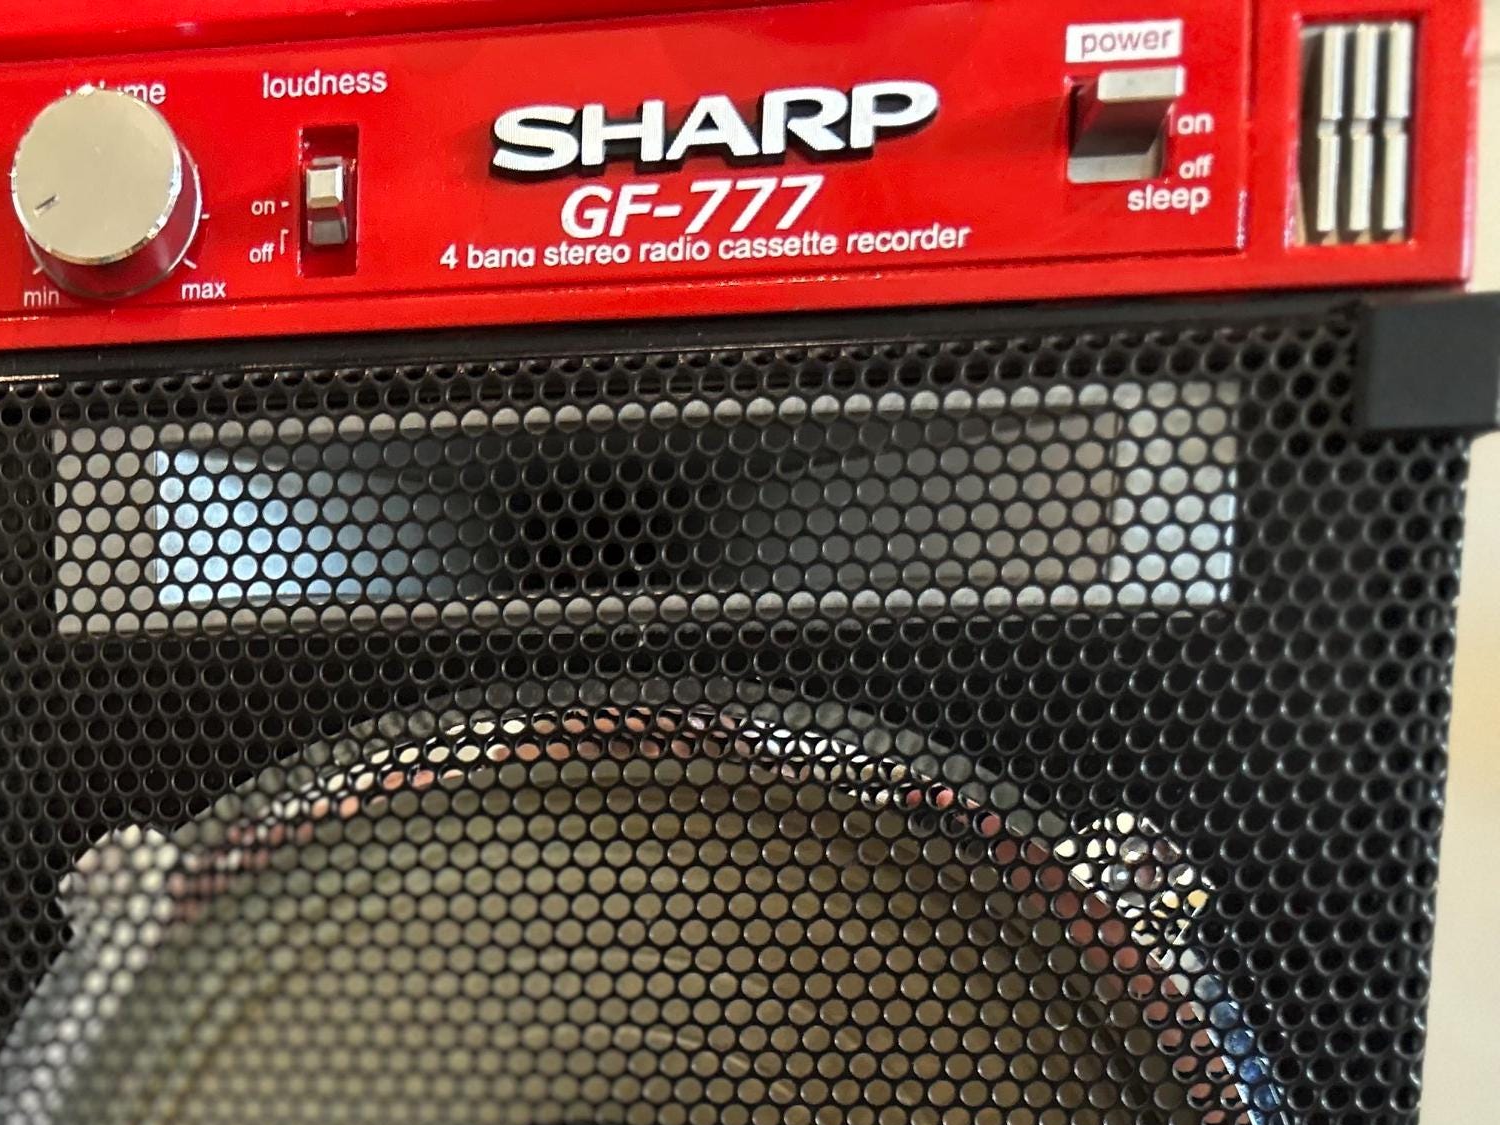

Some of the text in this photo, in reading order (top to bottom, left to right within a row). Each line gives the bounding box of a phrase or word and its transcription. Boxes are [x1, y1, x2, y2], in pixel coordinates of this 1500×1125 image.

[1080, 27, 1175, 57] power
[262, 70, 388, 98] loudness
[492, 80, 940, 179] SHARP
[1177, 113, 1213, 134] on
[1179, 156, 1212, 180] off
[251, 199, 276, 216] on
[560, 174, 825, 239] GF-777
[1127, 186, 1211, 215] sleep
[249, 242, 274, 264] off
[439, 243, 459, 270] 4
[543, 241, 631, 267] stereo
[639, 236, 710, 263] radio
[718, 230, 837, 260] cassette
[847, 221, 972, 255] recorder
[23, 287, 60, 308] min
[181, 279, 227, 301] max
